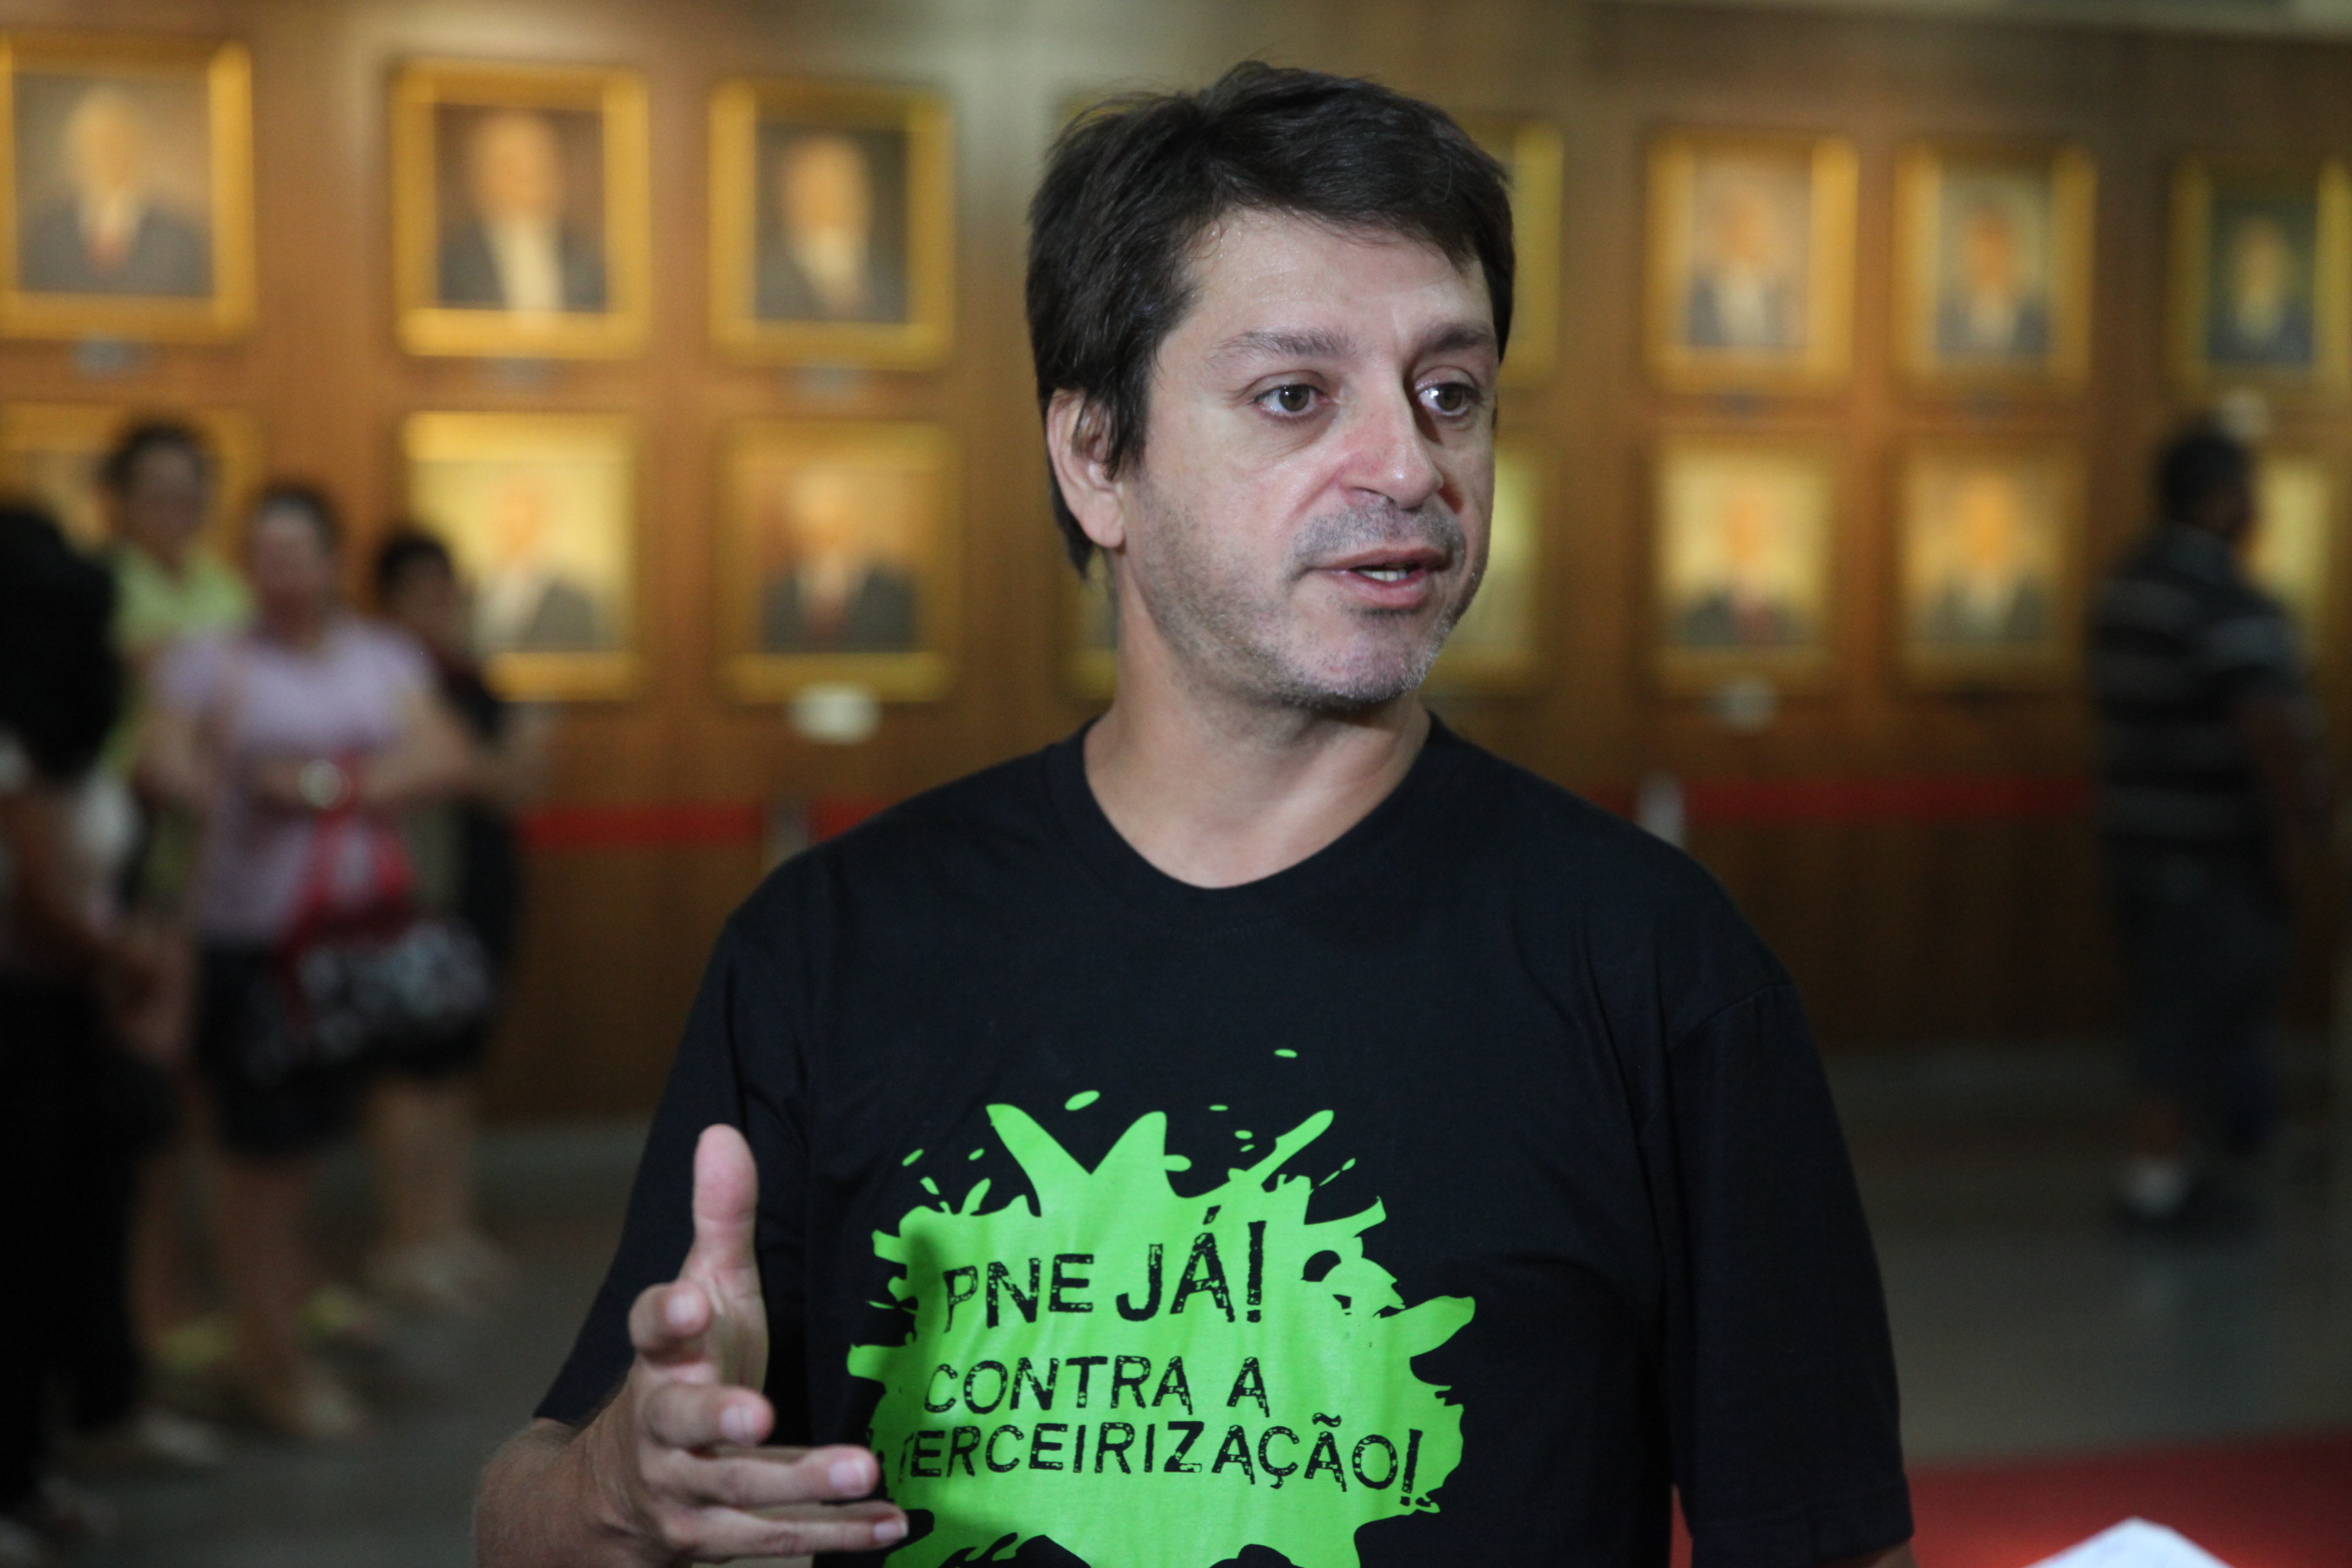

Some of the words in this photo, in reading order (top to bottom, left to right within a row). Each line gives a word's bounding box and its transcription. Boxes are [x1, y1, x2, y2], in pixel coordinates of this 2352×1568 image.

[943, 1253, 1094, 1333] PNE
[1115, 1205, 1267, 1323] JÁ!
[923, 1355, 1194, 1416] CONTRA
[1227, 1356, 1271, 1418] A
